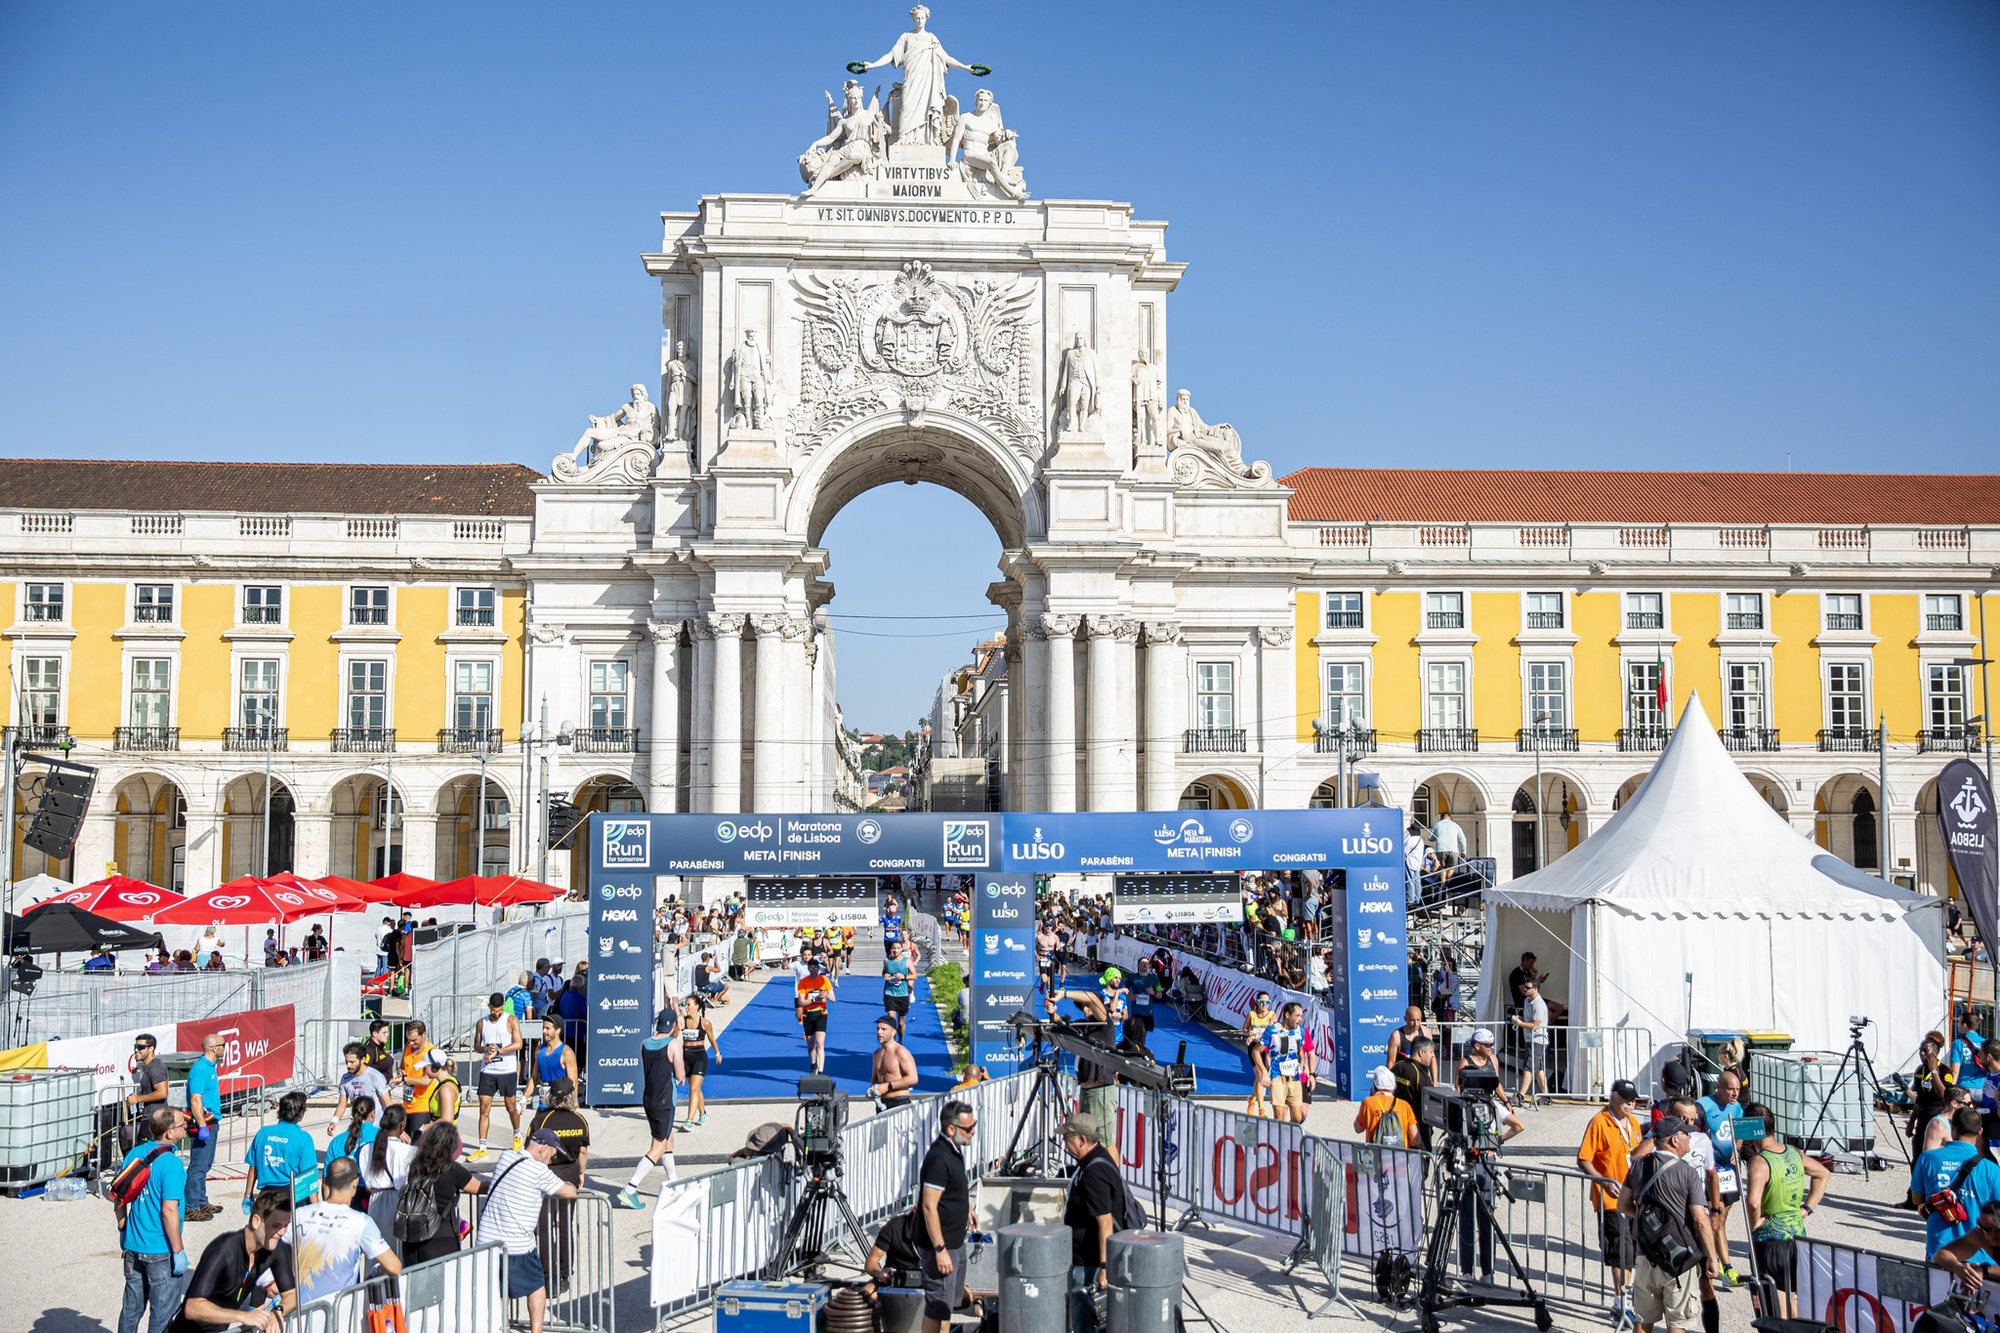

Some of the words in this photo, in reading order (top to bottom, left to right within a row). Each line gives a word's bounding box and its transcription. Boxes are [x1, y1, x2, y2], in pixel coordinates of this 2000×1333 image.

[885, 167, 950, 180] VIRTVTIBVS
[892, 184, 942, 198] MAIORVM
[627, 826, 645, 837] edp
[738, 820, 773, 843] edp
[788, 821, 842, 831] Maratona
[966, 826, 984, 838] edp
[788, 833, 802, 843] de
[804, 833, 841, 843] Lisboa
[608, 843, 643, 856] Run
[743, 851, 777, 861] META
[783, 850, 820, 861] FINISH
[949, 843, 982, 856] Run
[1167, 848, 1199, 858] META
[1205, 847, 1241, 857] FINISH
[869, 859, 925, 868] CONGRATS!
[1080, 855, 1134, 866] PARABÉNS!
[1273, 853, 1327, 862] CONGRATS!
[669, 858, 725, 870] PARABÉNS!
[617, 883, 642, 900] edp
[1001, 881, 1026, 898] edp
[1360, 901, 1393, 913] HOKA
[602, 909, 639, 922] HOKA
[612, 999, 639, 1007] LISBOA
[1227, 985, 1258, 1018] LUS
[245, 1039, 269, 1058] WAY
[599, 1058, 639, 1067] CASCAIS
